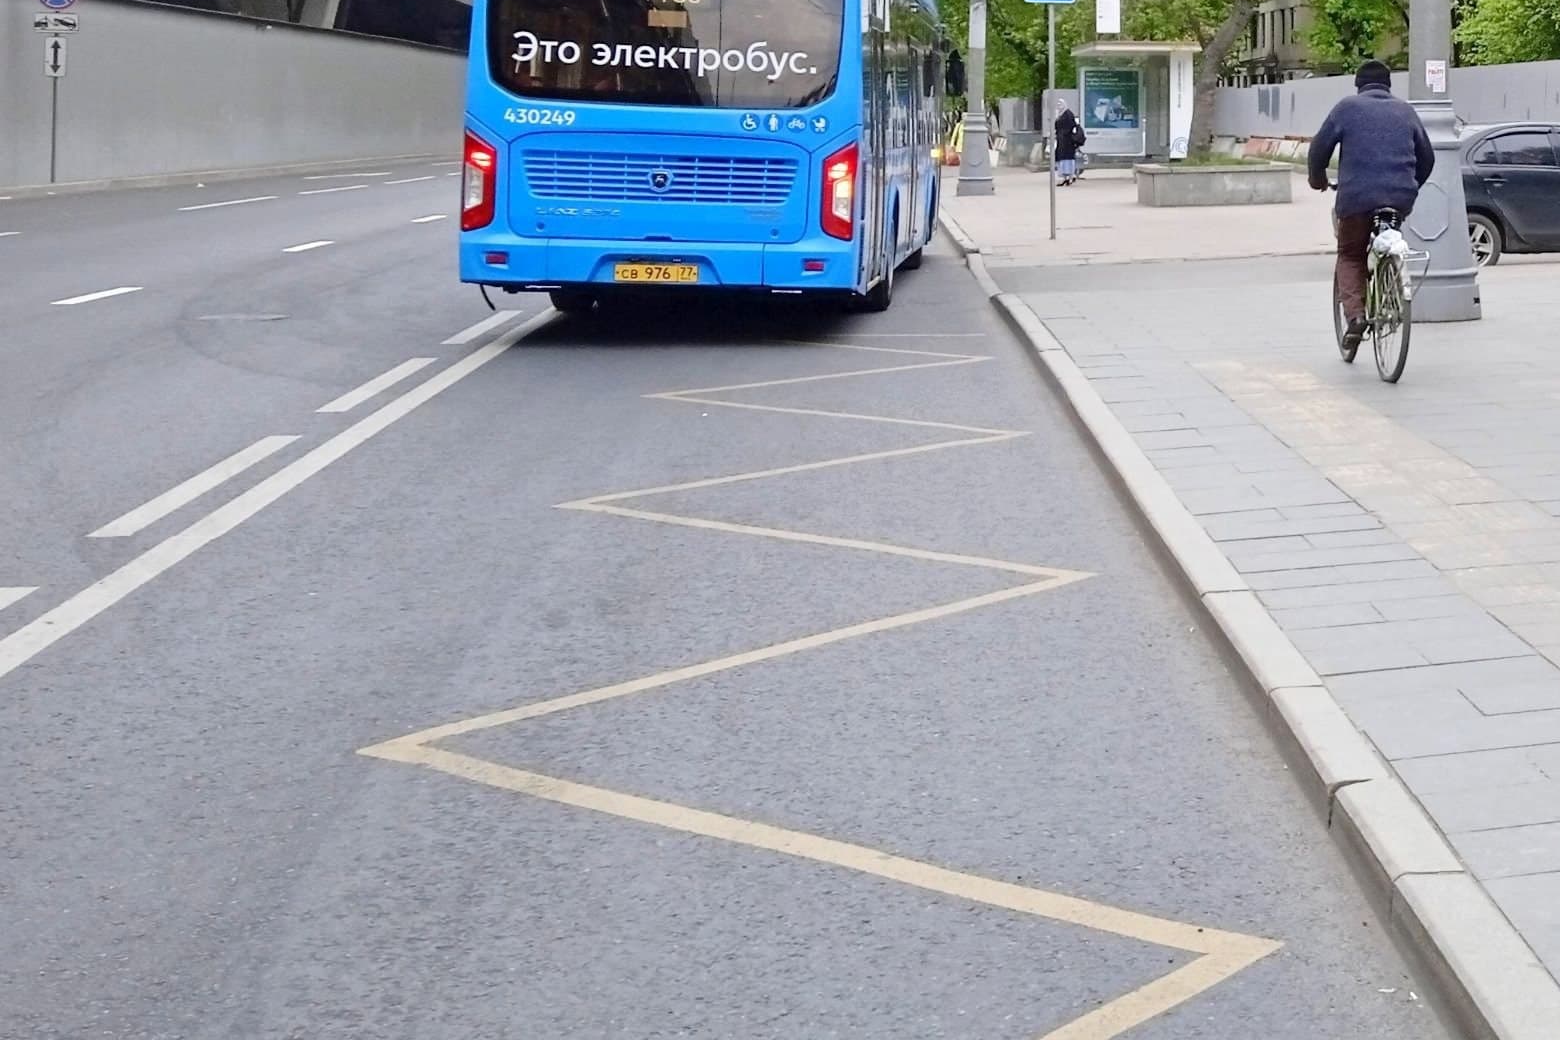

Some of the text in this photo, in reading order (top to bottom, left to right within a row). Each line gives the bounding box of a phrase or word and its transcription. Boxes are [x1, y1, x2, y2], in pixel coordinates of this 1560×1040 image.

[511, 30, 817, 79] Это электробус.
[503, 108, 576, 126] 430249
[645, 266, 671, 280] 976
[680, 266, 694, 277] 77
